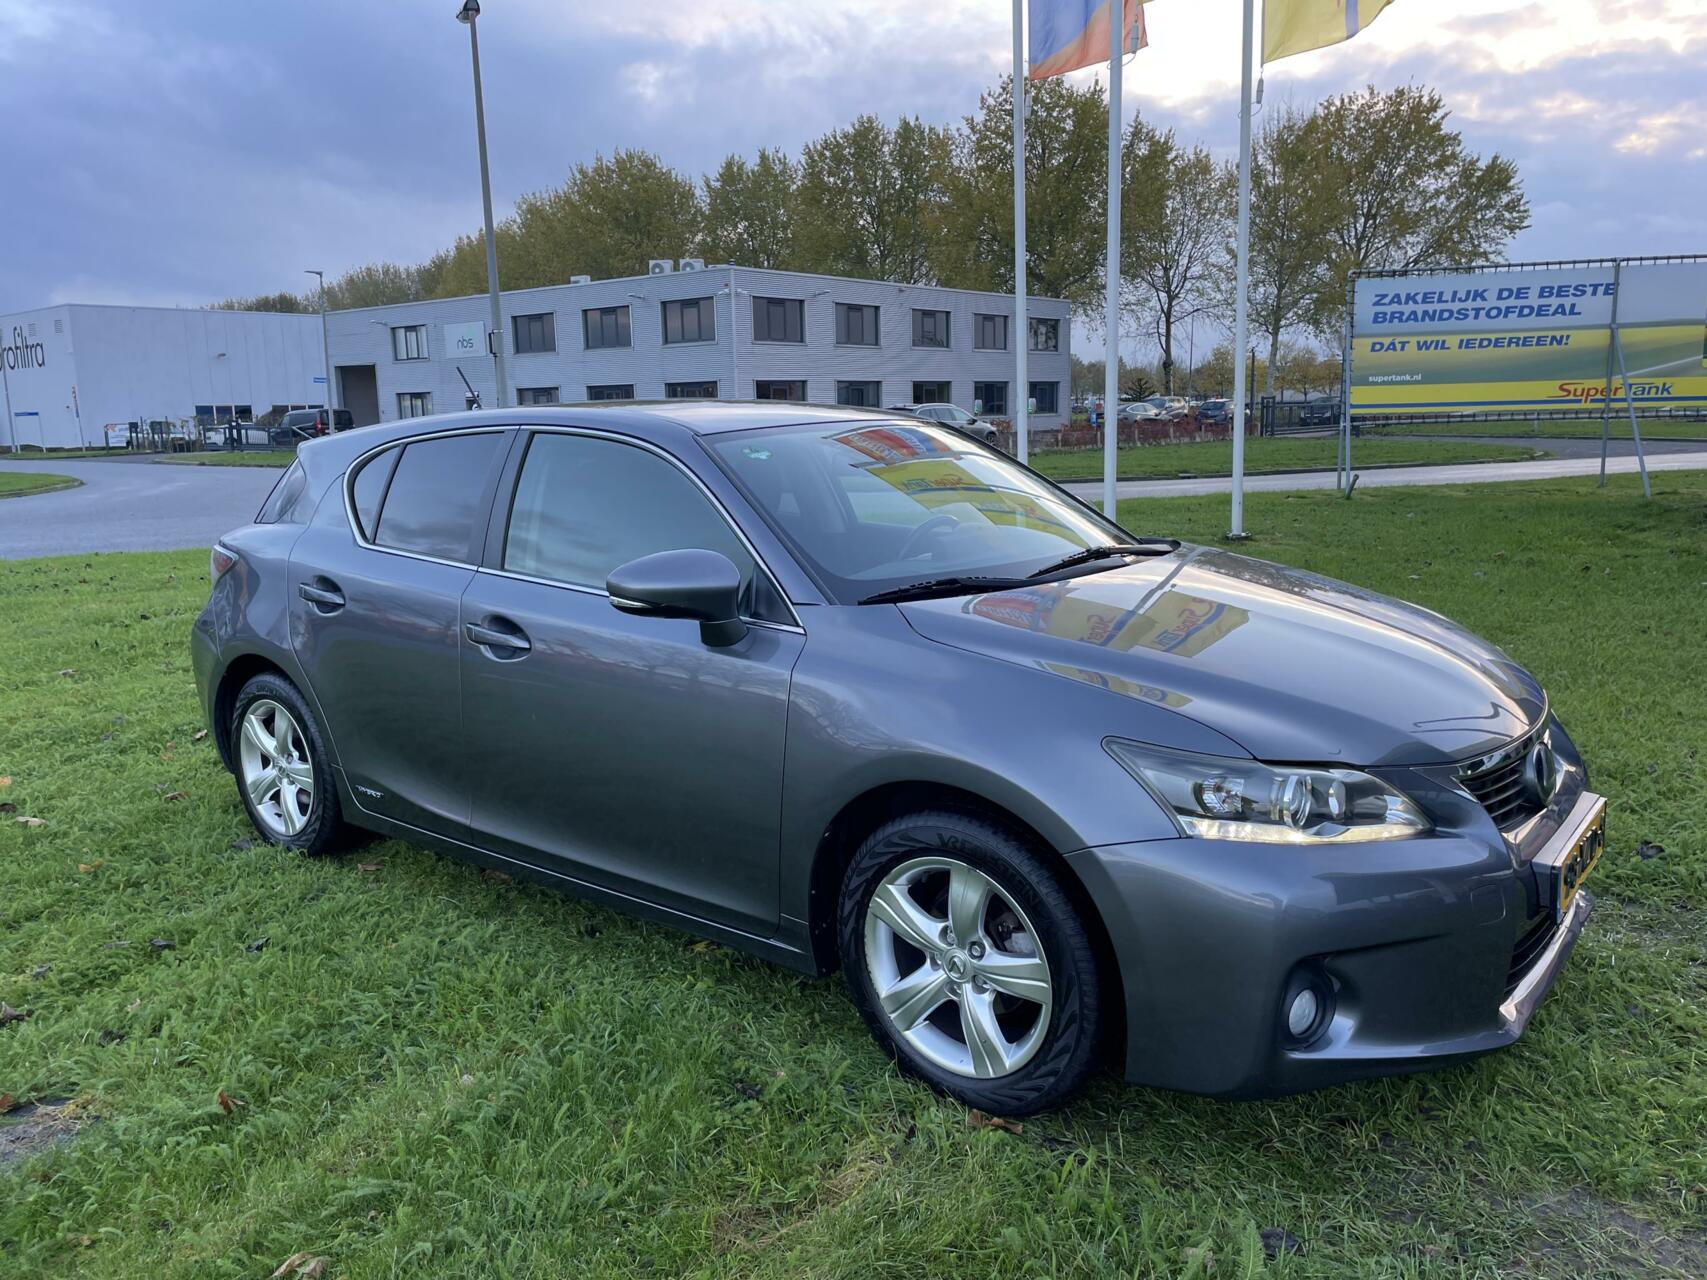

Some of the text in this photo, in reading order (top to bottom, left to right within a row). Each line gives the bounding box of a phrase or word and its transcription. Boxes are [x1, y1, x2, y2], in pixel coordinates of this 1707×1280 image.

[1372, 282, 1616, 307] ZAKELIJK DE BESTE
[1372, 302, 1582, 325] BRANDSTOFDEAL
[0, 325, 46, 371] rofiltra
[1370, 334, 1571, 353] DÁT WIL IEDEREEN!
[1368, 373, 1423, 384] supertank.nl
